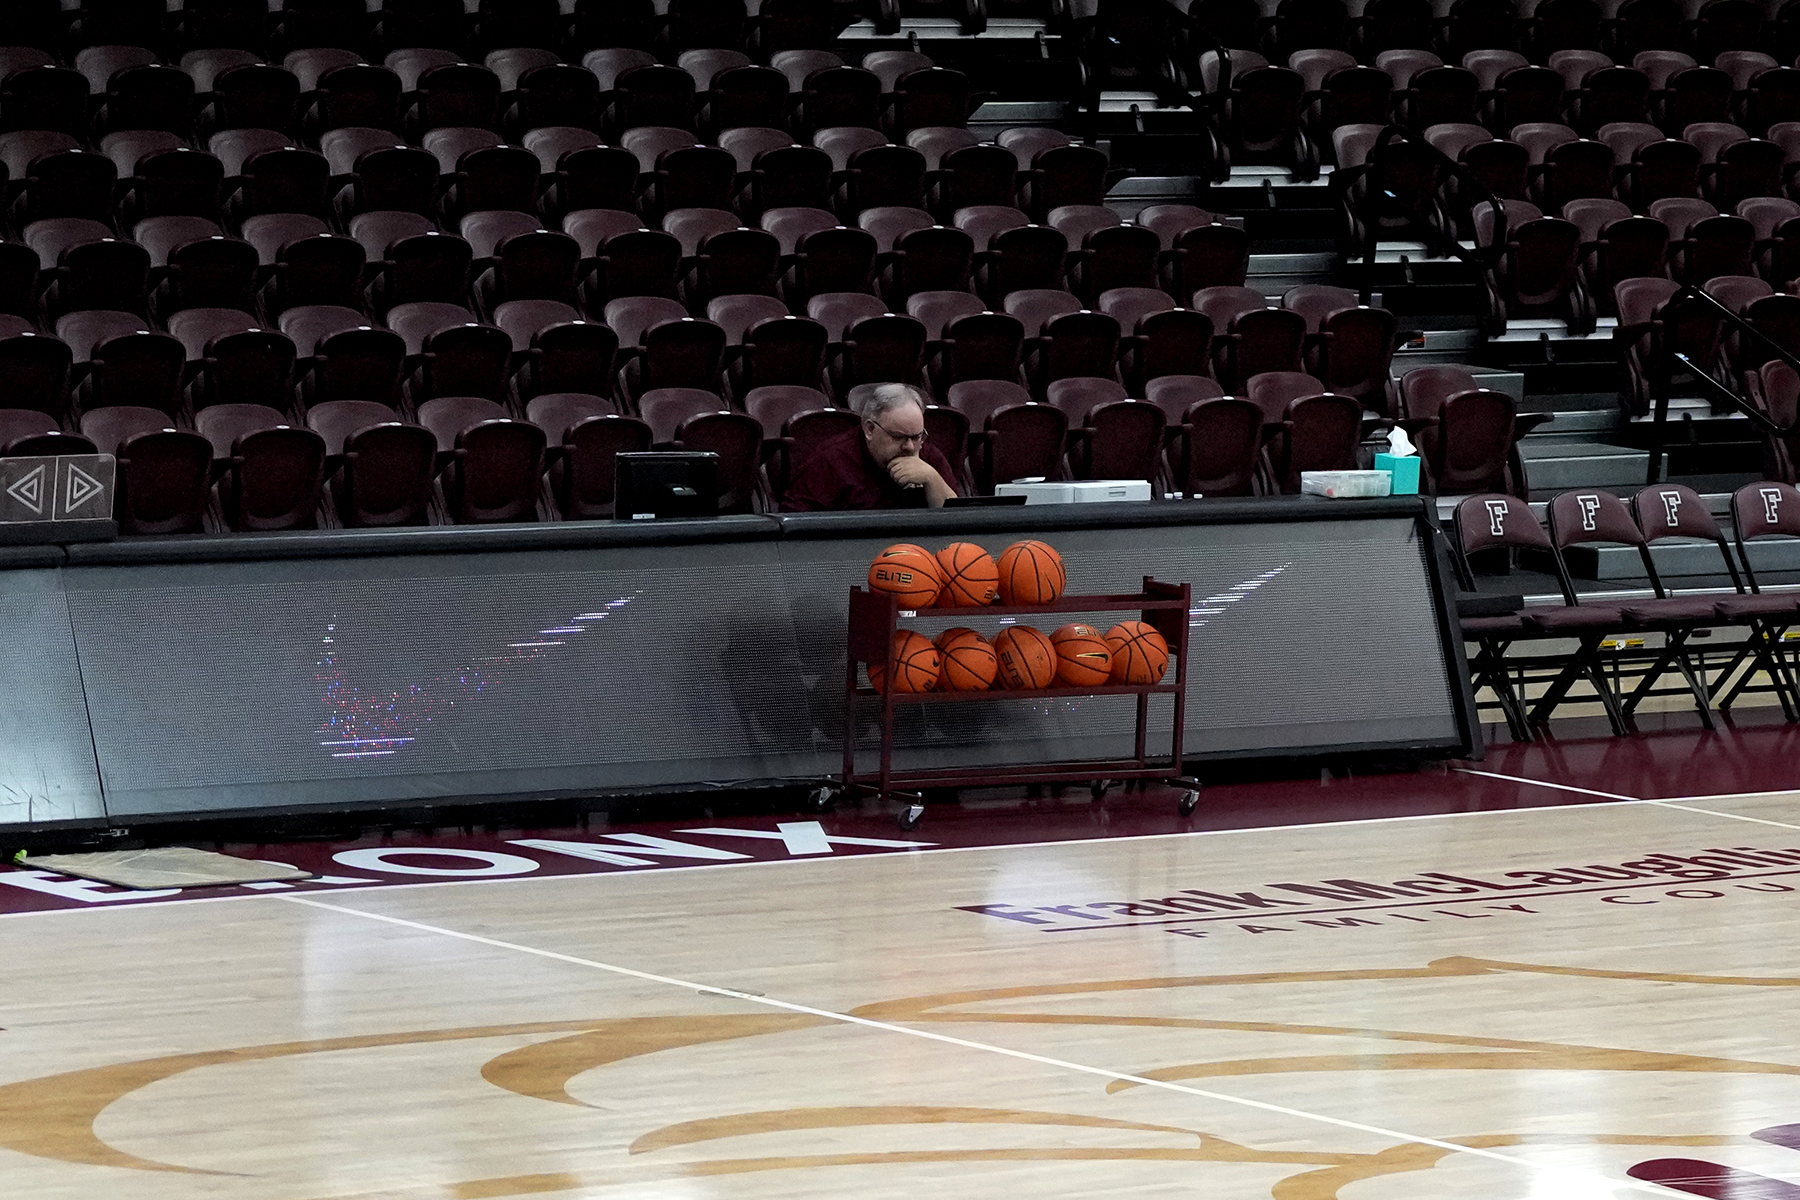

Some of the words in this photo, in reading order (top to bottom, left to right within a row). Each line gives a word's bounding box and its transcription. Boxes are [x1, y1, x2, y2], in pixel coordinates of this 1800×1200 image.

[1484, 499, 1509, 536] F
[1575, 494, 1601, 531] F
[1658, 490, 1682, 527] F
[1758, 487, 1783, 524] F
[876, 570, 914, 585] ELITE
[1001, 651, 1025, 688] ELITE
[951, 889, 1313, 926] Frank
[1164, 903, 1539, 939] FAMILY
